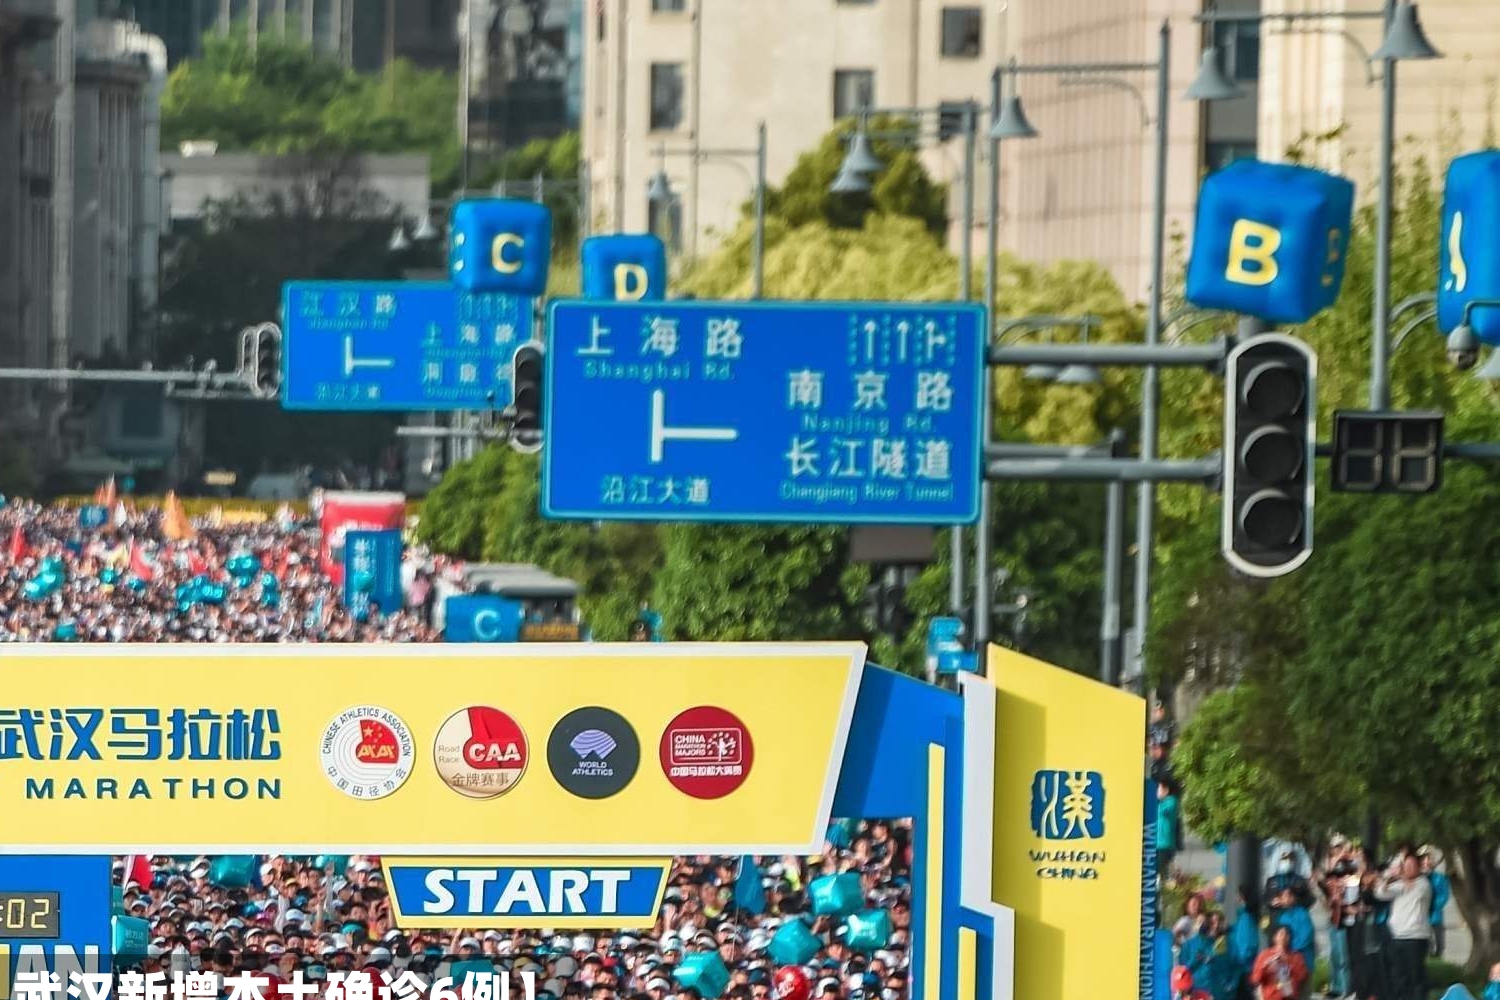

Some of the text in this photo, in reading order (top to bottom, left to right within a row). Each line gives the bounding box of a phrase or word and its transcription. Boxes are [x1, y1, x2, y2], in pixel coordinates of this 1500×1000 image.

[491, 233, 525, 274] C
[1225, 219, 1281, 286] B
[577, 315, 743, 358] 上海路
[583, 361, 690, 380] Shanghai
[788, 370, 952, 412] 南京路
[804, 415, 889, 434] Nanjing
[786, 437, 949, 479] 长江隧道
[603, 476, 710, 504] 沿江大道
[474, 610, 501, 638] C
[674, 735, 706, 743] CHINA
[469, 743, 521, 762] CAA
[25, 777, 282, 799] MARATHON
[451, 773, 509, 786] 金牌赛事
[1028, 850, 1105, 863] WUHAN
[1036, 867, 1100, 880] CHINA
[423, 870, 631, 913] START
